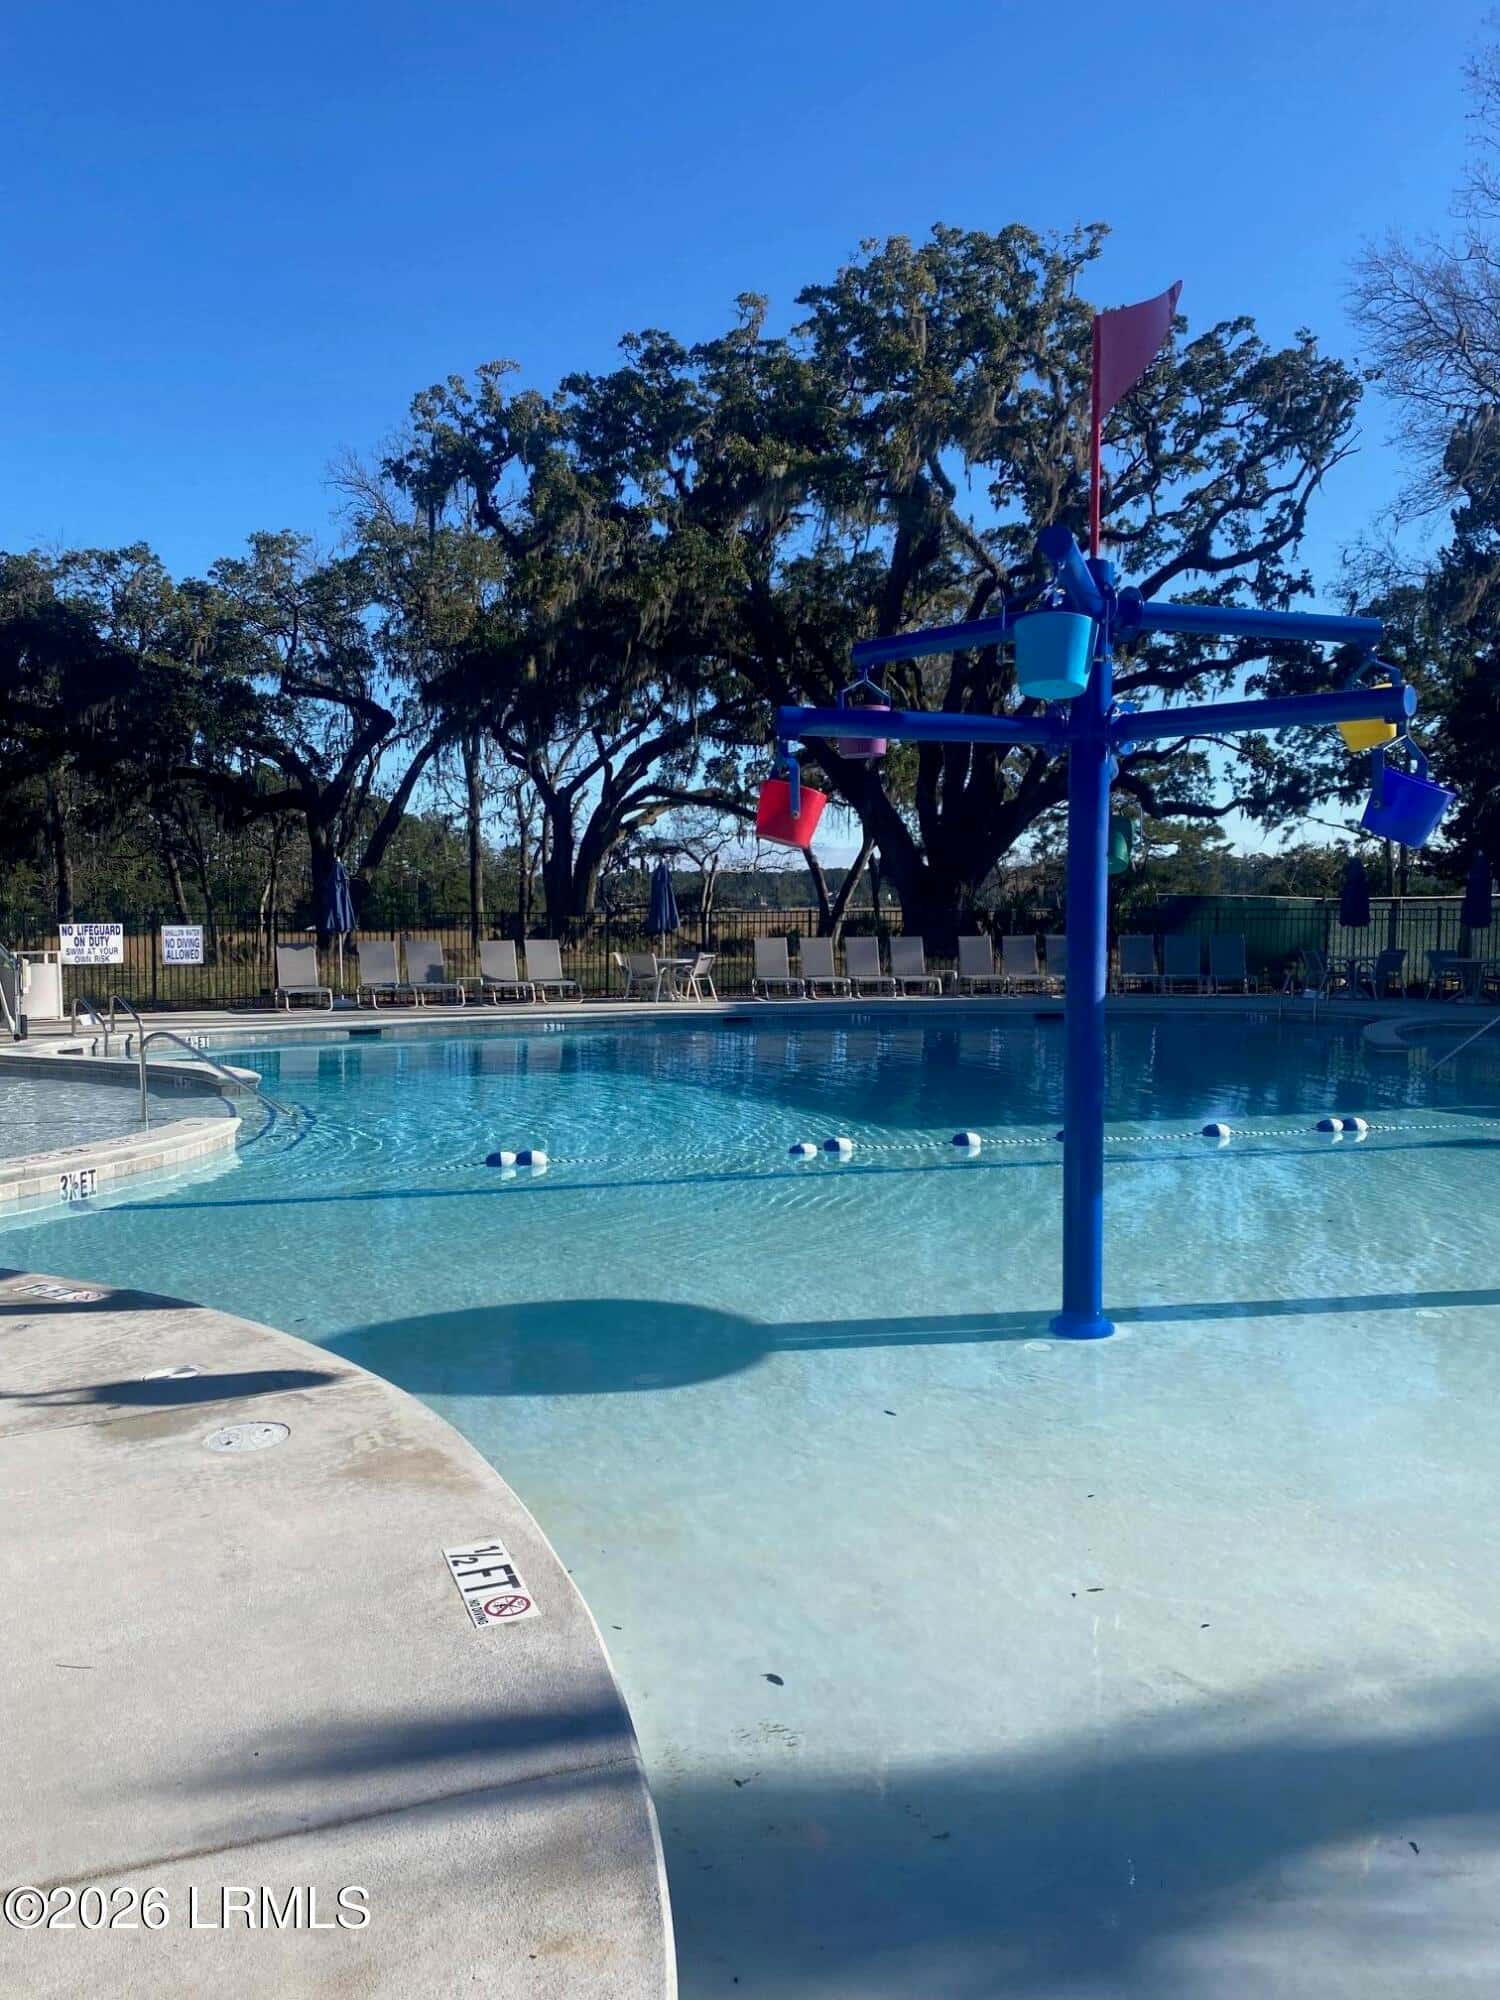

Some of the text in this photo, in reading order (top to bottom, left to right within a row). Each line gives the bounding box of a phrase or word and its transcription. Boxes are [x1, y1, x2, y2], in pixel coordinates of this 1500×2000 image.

[61, 925, 120, 936] NO LIFEGUARD
[74, 936, 109, 947] ON DUTY
[165, 938, 200, 948] NO DIVING
[166, 949, 200, 959] ALLOWED
[457, 1564, 522, 1593] FT
[471, 1606, 489, 1625] DIVING
